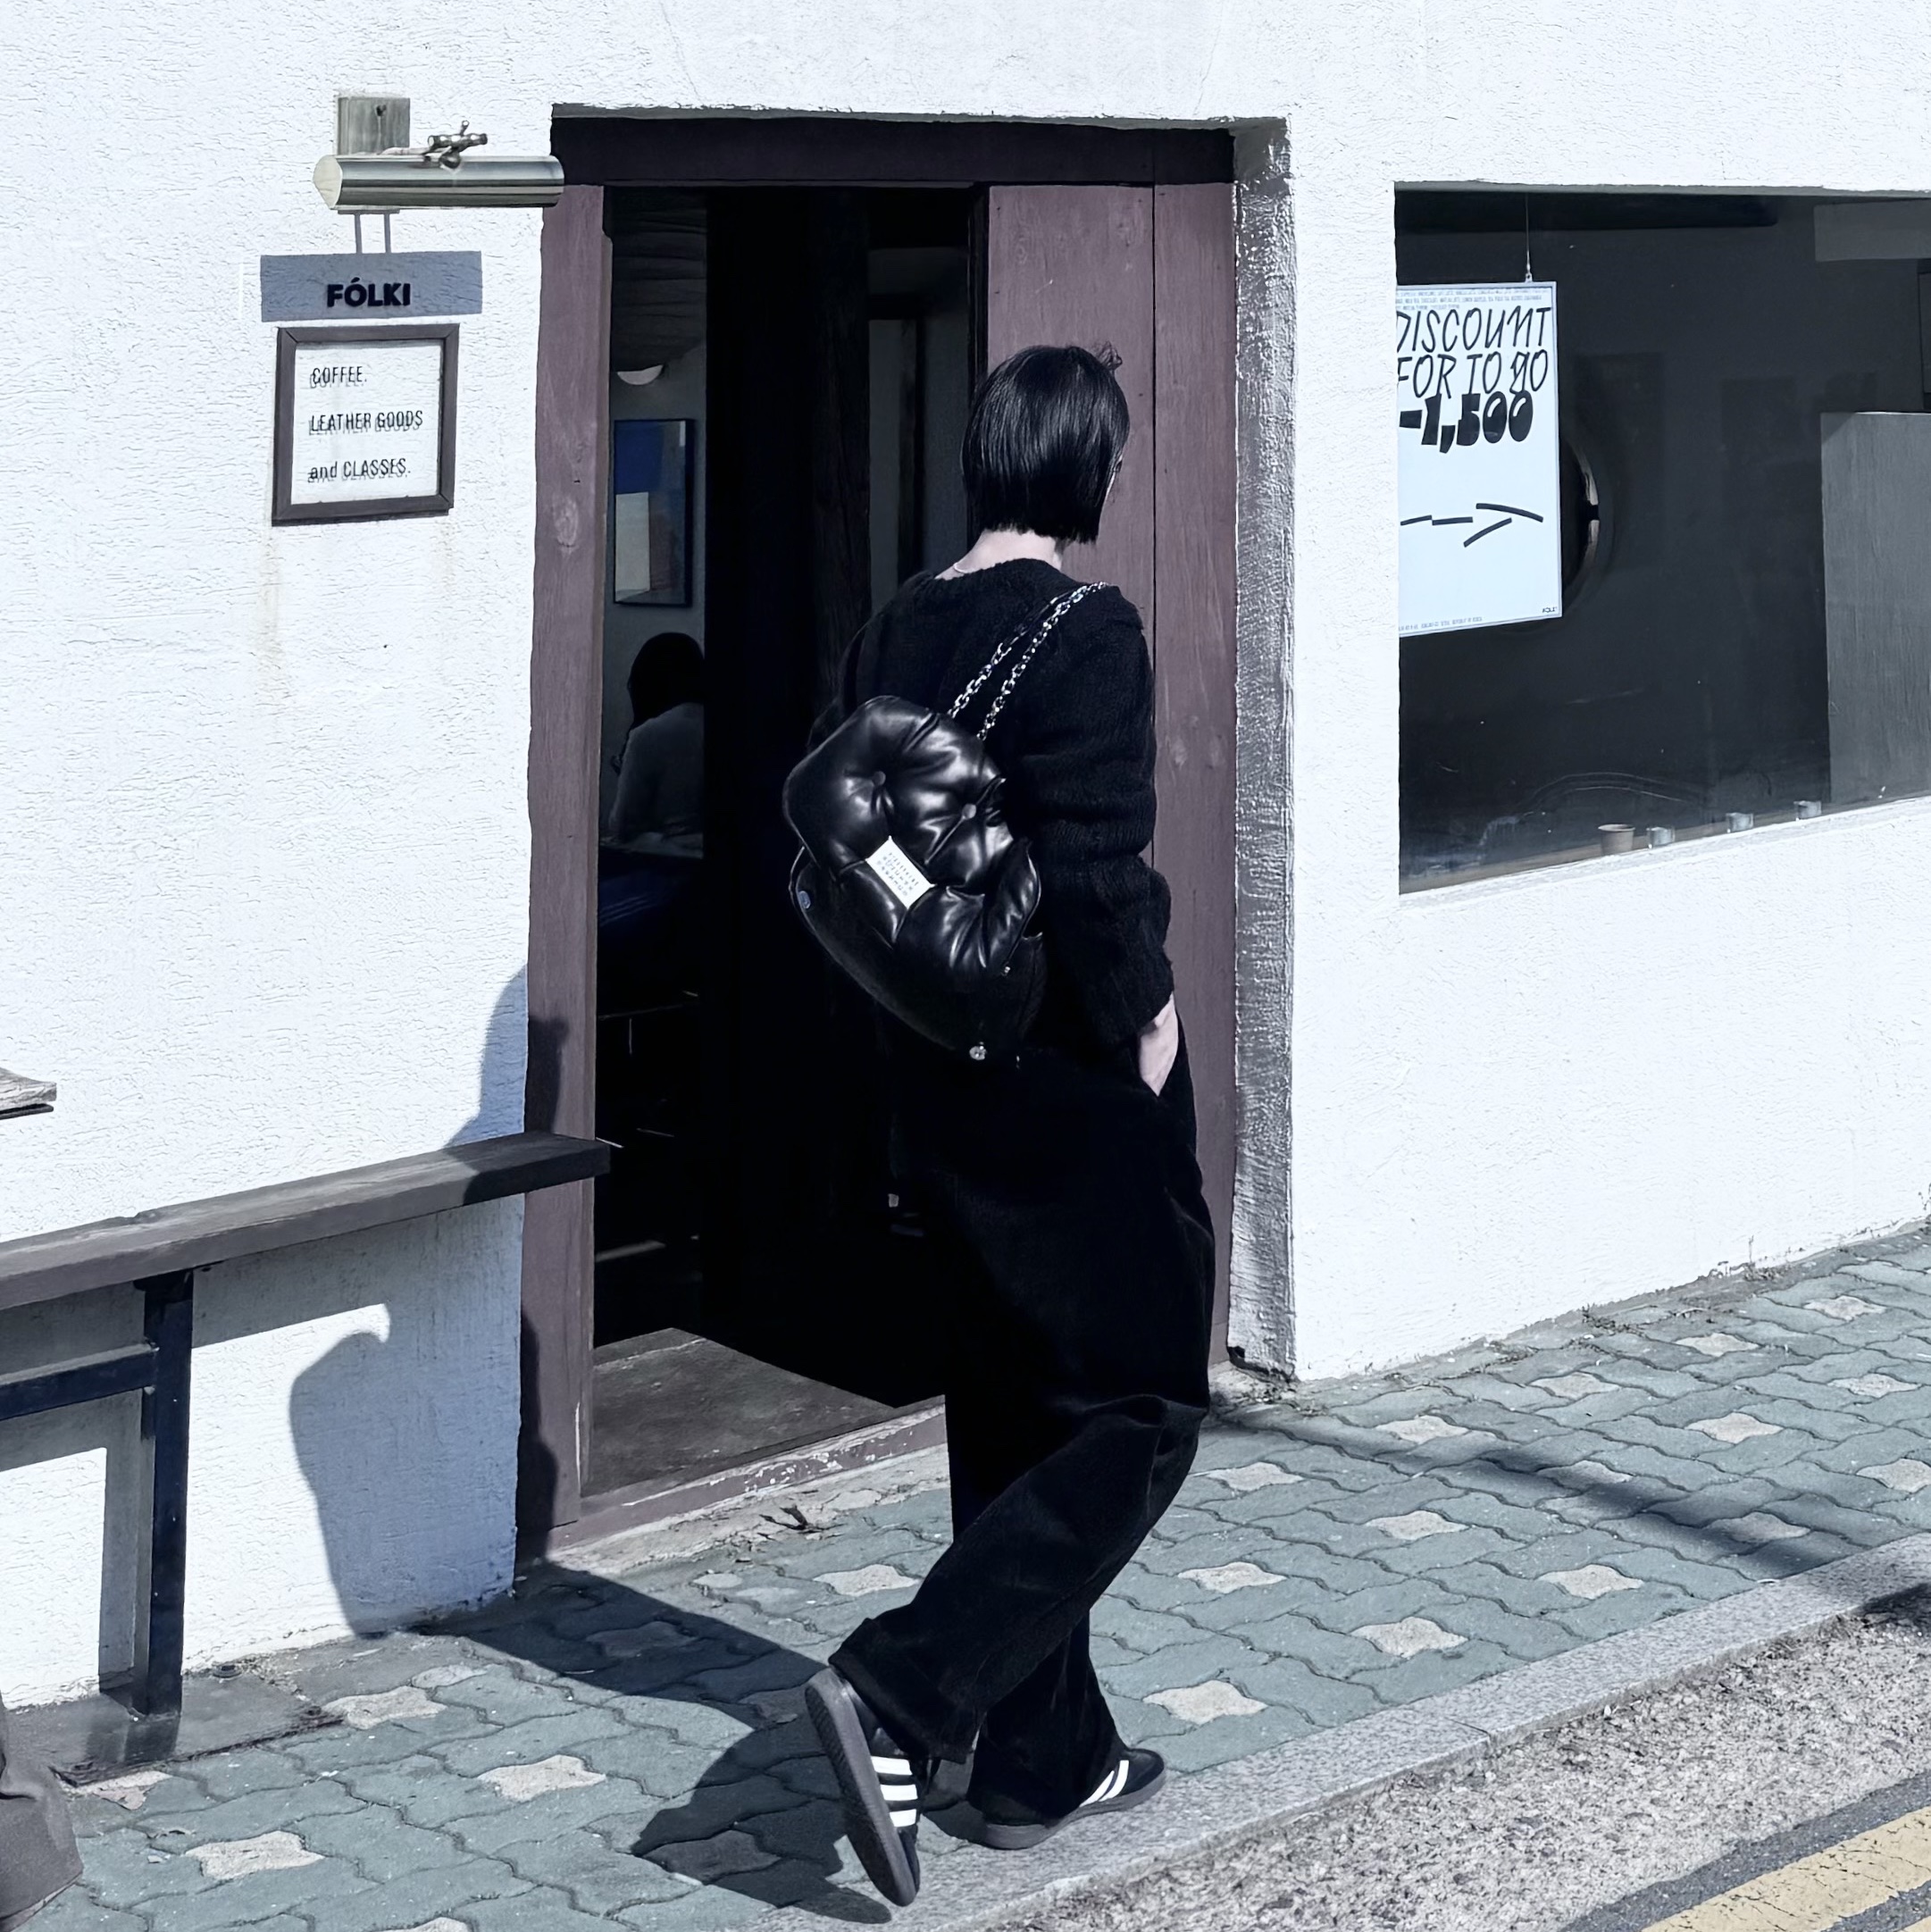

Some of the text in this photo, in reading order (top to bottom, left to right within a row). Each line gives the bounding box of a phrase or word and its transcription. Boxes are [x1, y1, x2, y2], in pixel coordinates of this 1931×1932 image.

[326, 277, 412, 307] FÓLKI
[1397, 305, 1551, 353] DISCOUNT
[312, 366, 367, 385] COFFEE.
[1398, 354, 1457, 399] FOR
[1466, 351, 1502, 395] TO
[311, 410, 423, 432] LEATHER GOODS
[1399, 390, 1534, 454] -1,500
[310, 457, 412, 480] and CLASSES.
